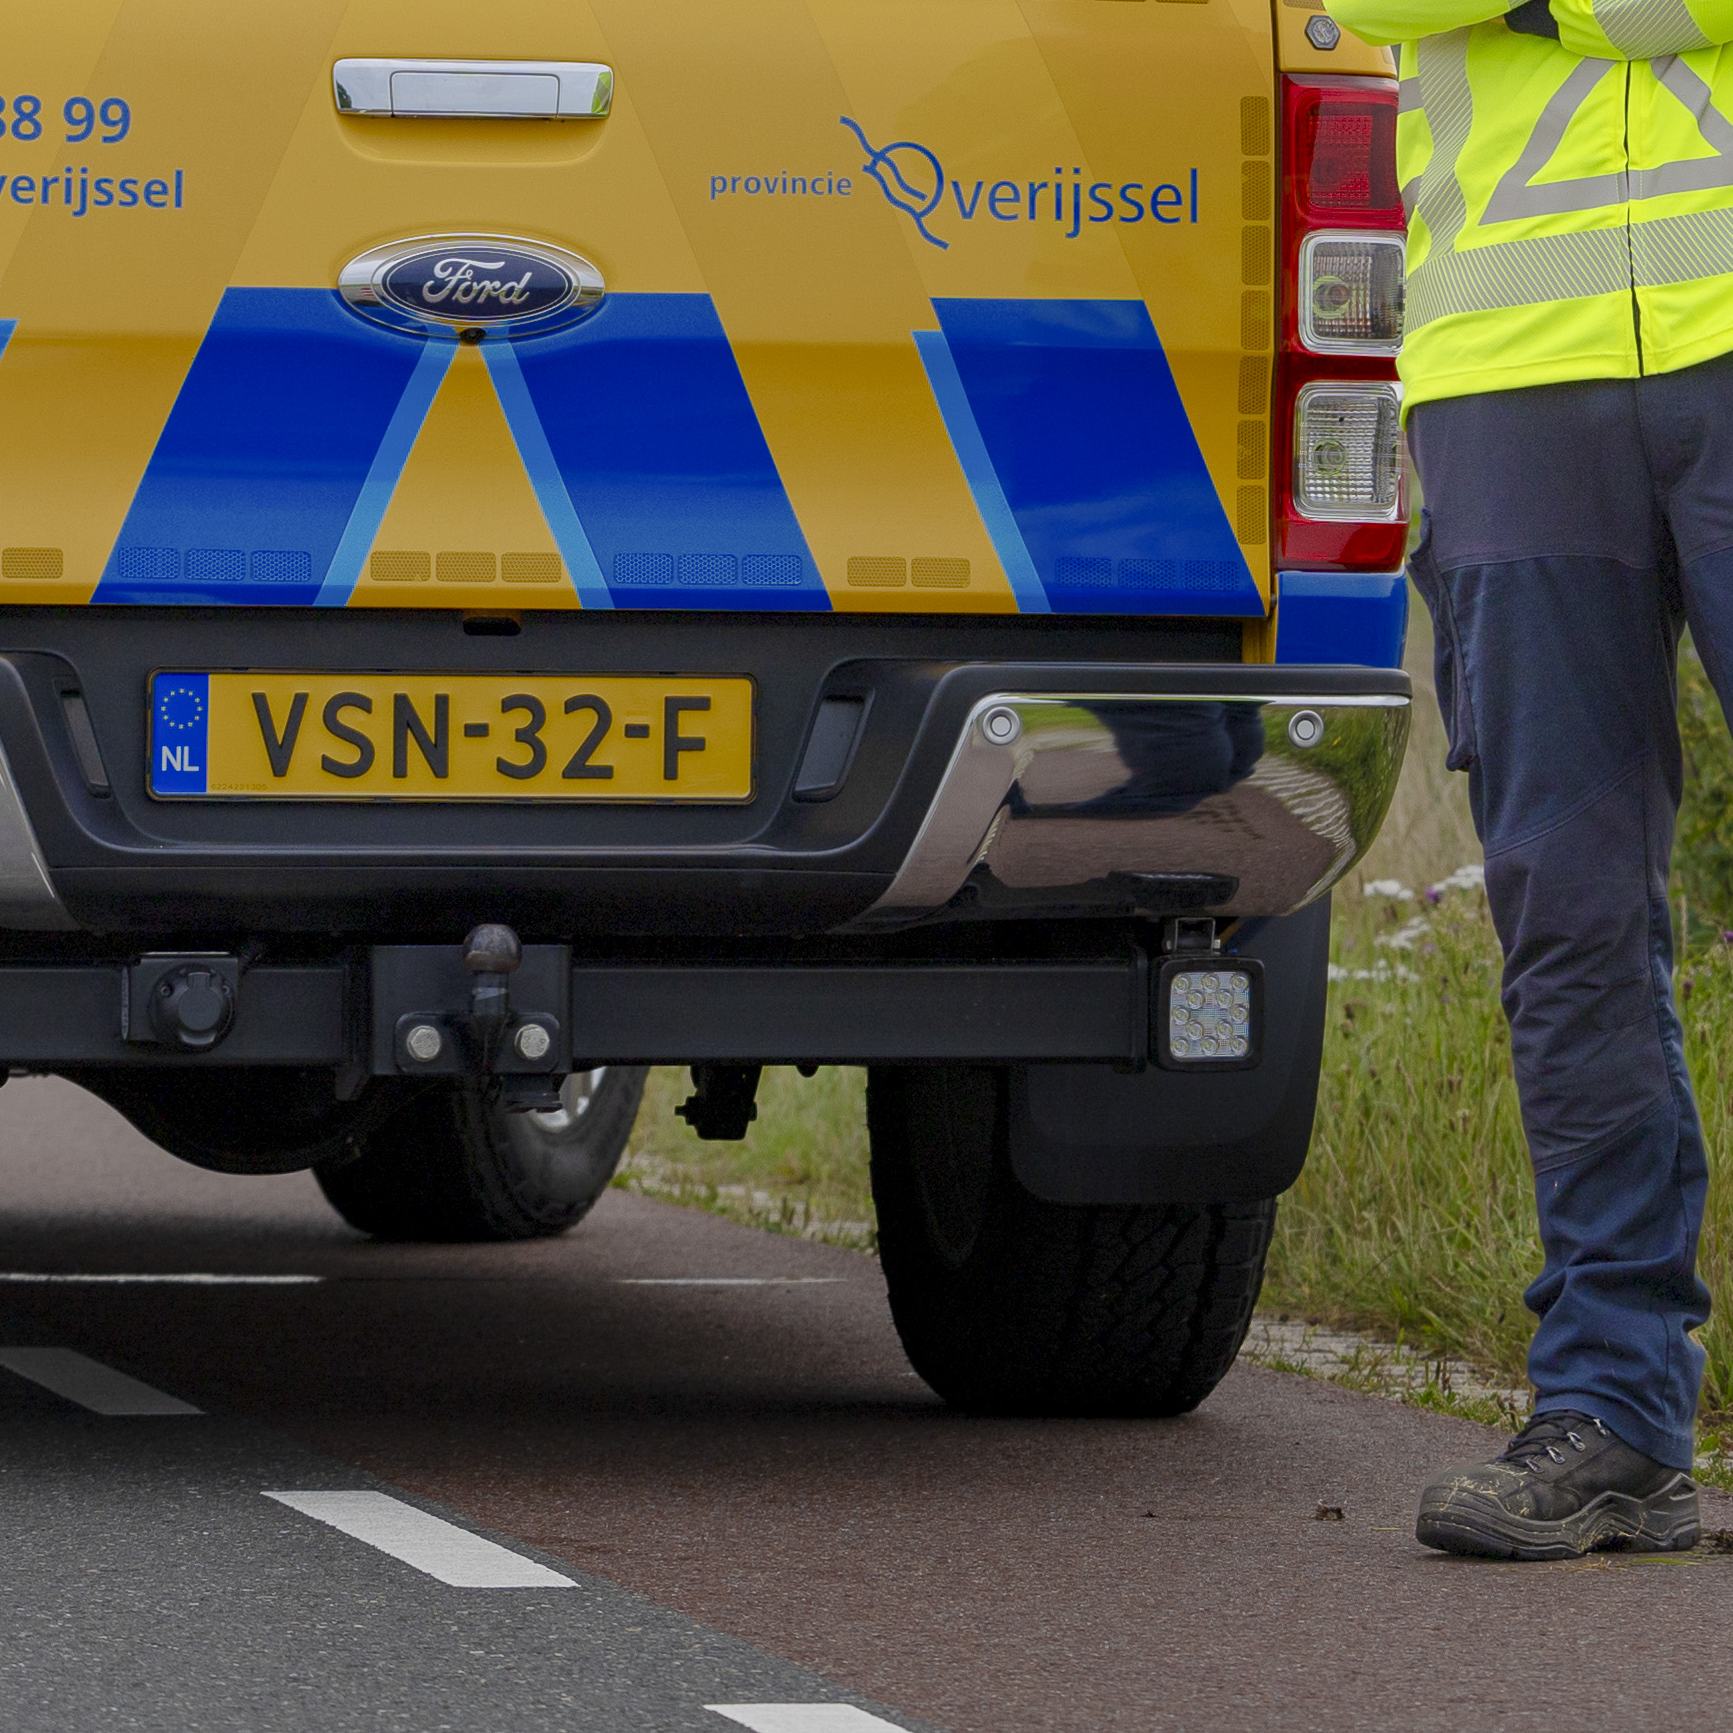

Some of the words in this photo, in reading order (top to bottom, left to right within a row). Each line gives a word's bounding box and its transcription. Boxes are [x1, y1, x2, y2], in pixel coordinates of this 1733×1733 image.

[63, 96, 131, 144] 99
[709, 171, 853, 200] provincie
[422, 257, 533, 305] Ford
[161, 746, 200, 772] NL
[251, 692, 712, 780] VSN-32-F
